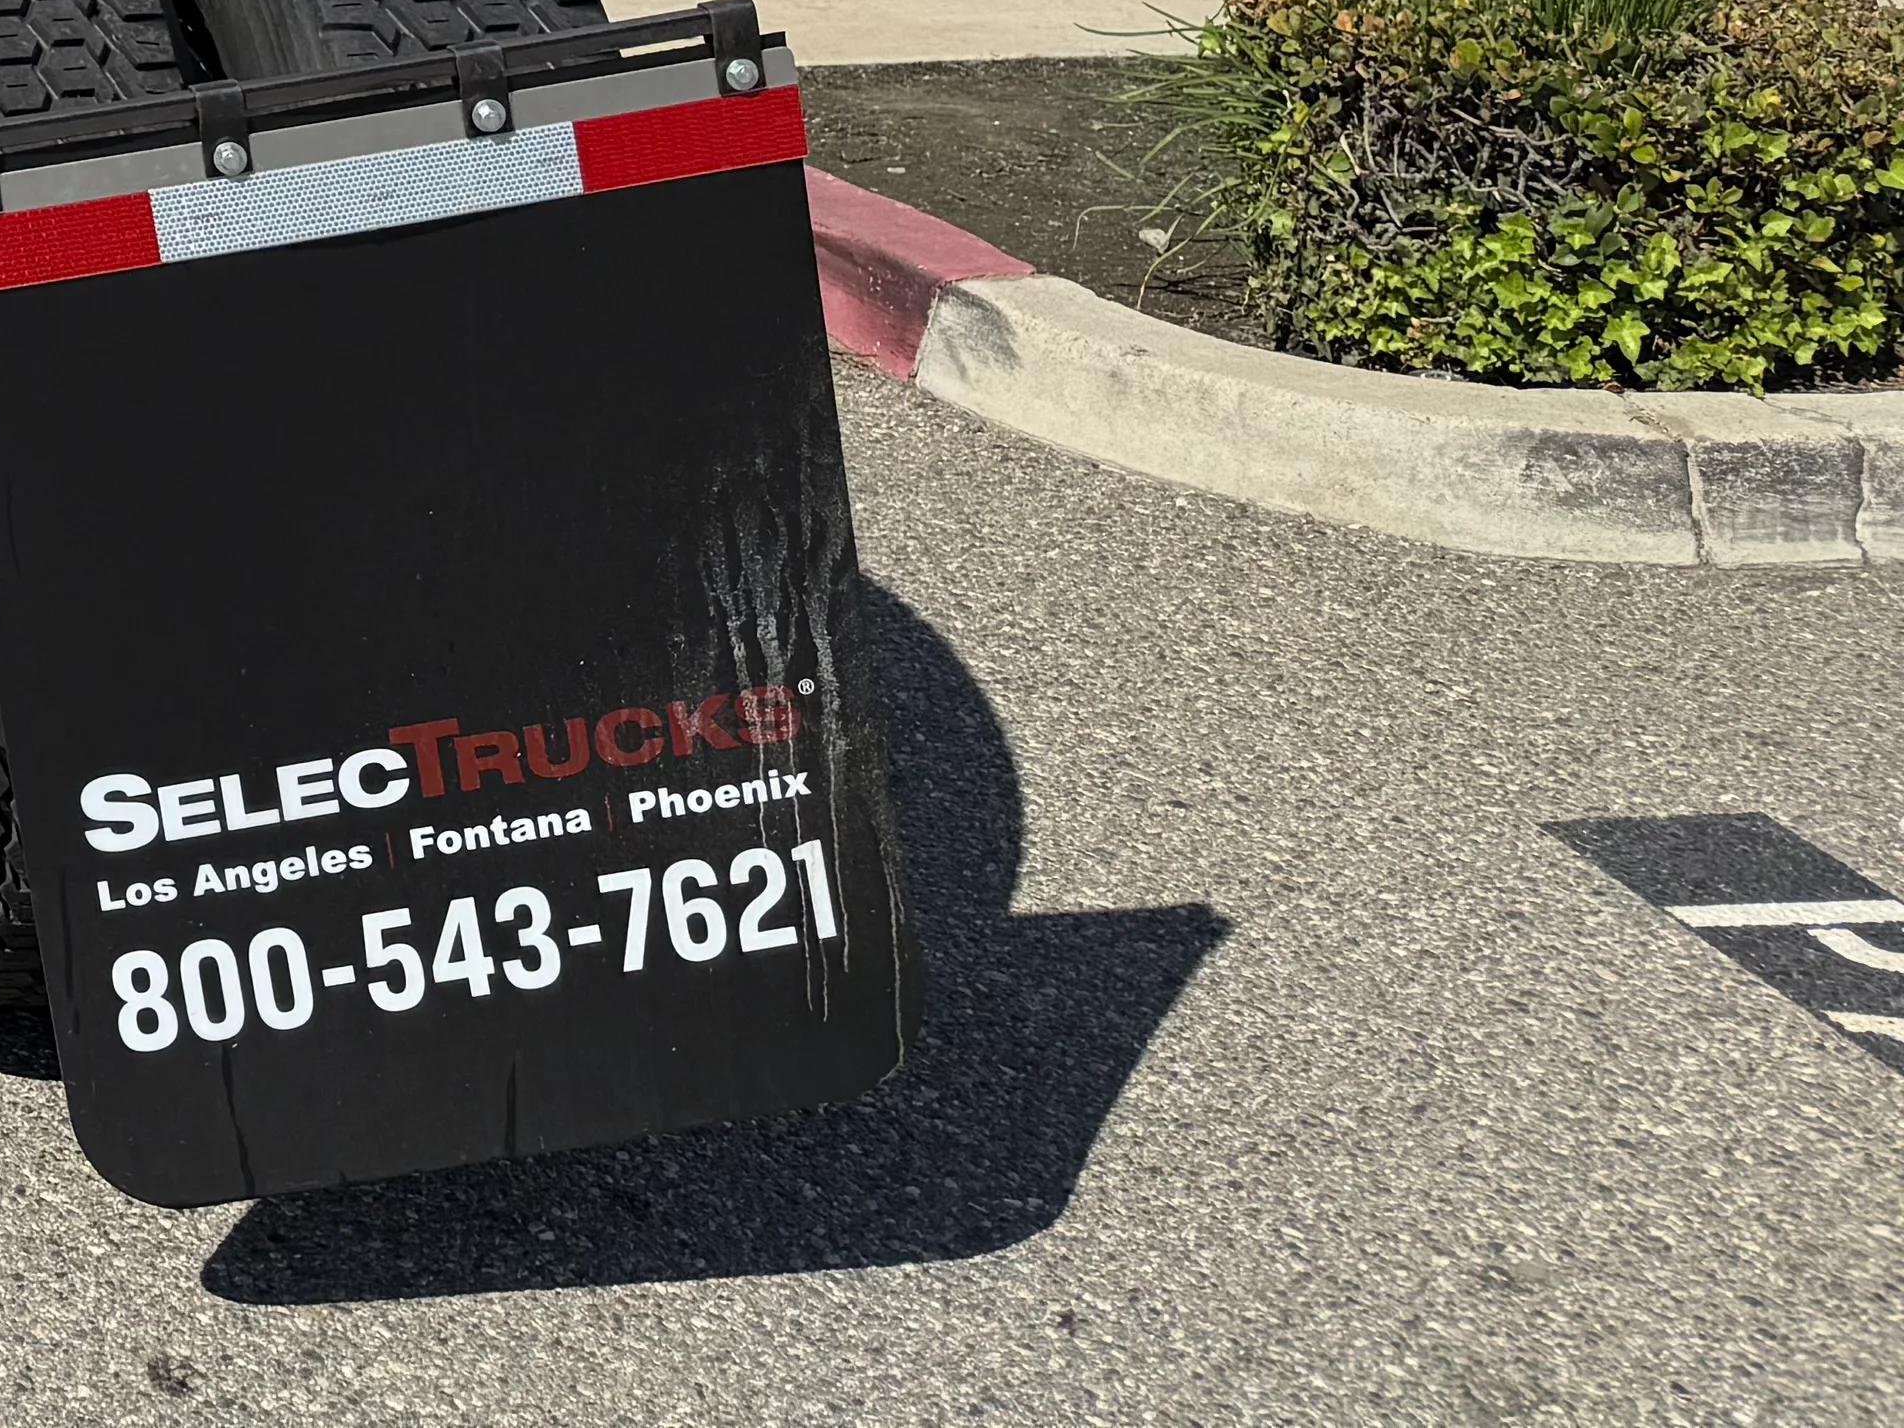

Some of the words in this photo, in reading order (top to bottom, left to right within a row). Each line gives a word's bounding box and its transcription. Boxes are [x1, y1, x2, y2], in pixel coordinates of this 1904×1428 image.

[96, 877, 178, 912] Los
[193, 844, 373, 897] Angeles
[409, 808, 593, 860] Fontana
[628, 768, 812, 823] Phoenix
[111, 837, 840, 1052] 800-543-7621
